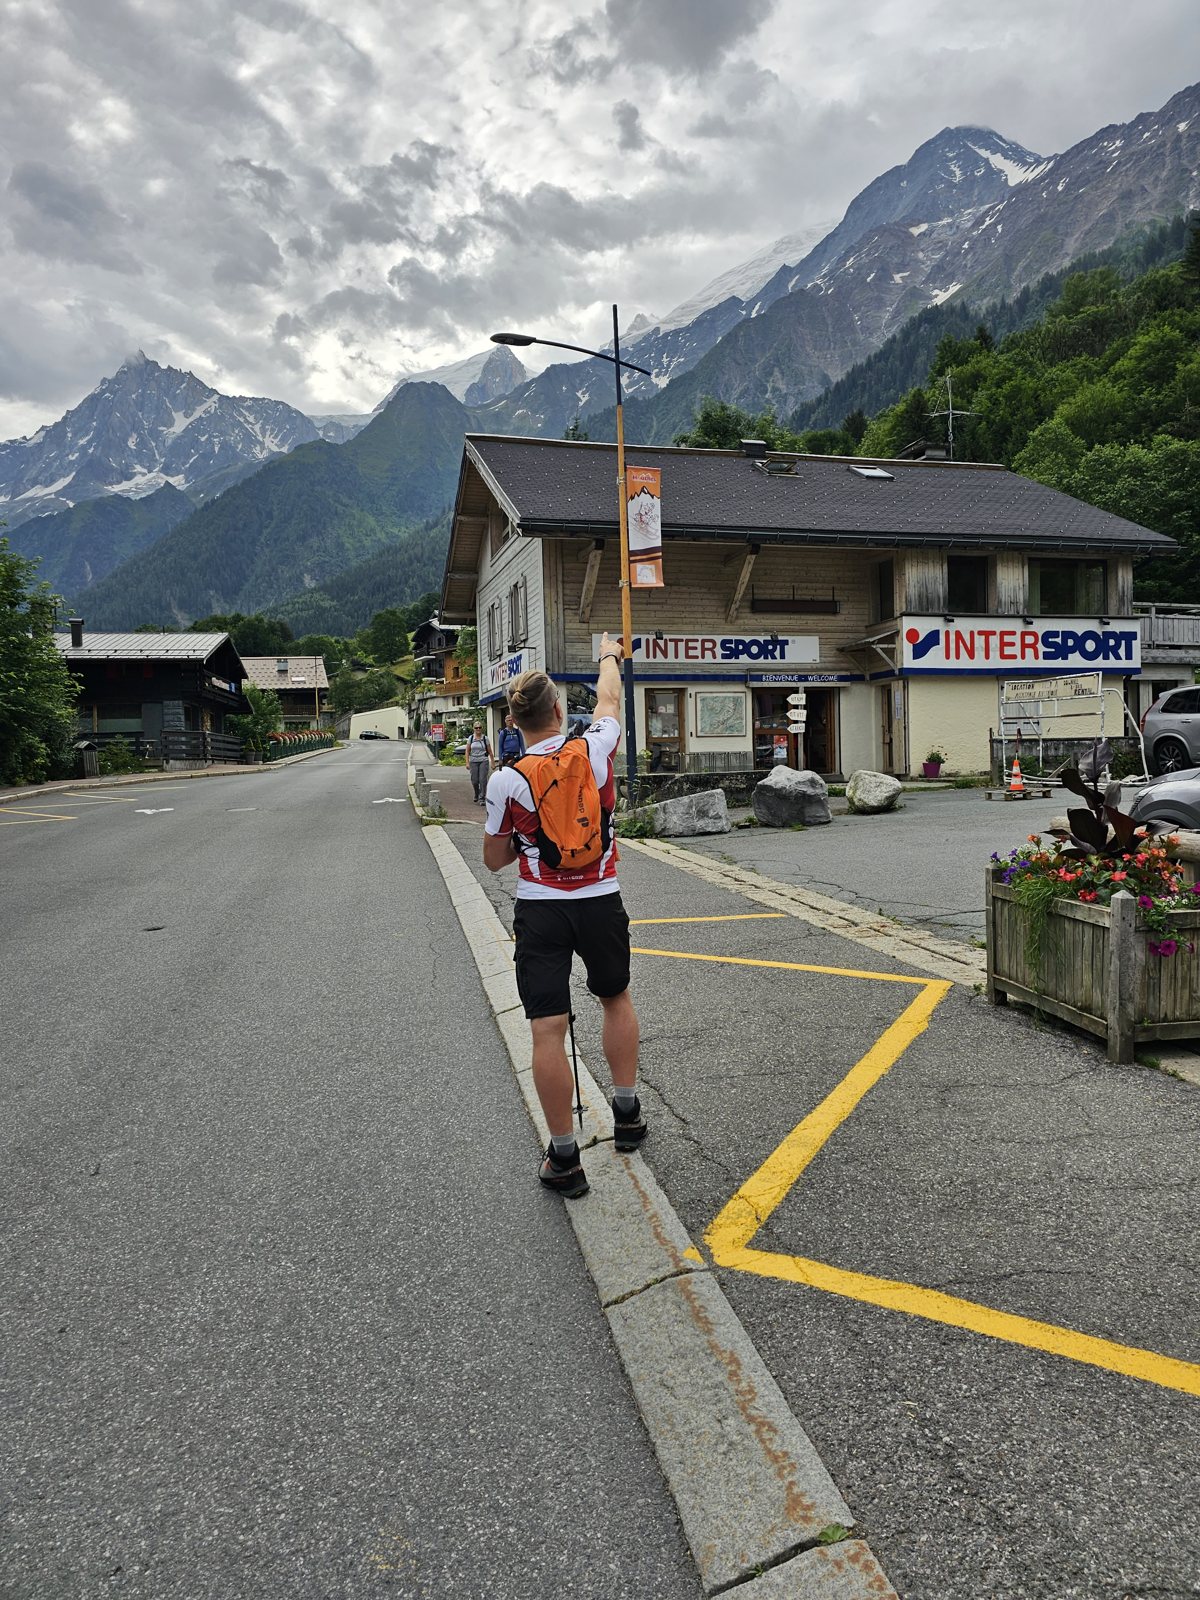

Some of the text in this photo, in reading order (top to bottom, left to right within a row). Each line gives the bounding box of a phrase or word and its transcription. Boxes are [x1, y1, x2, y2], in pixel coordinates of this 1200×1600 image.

[645, 637, 789, 660] INTERSPORT
[944, 629, 1138, 662] INTERSPORT
[762, 674, 799, 682] BIENVENUE
[807, 674, 838, 682] WELCOME
